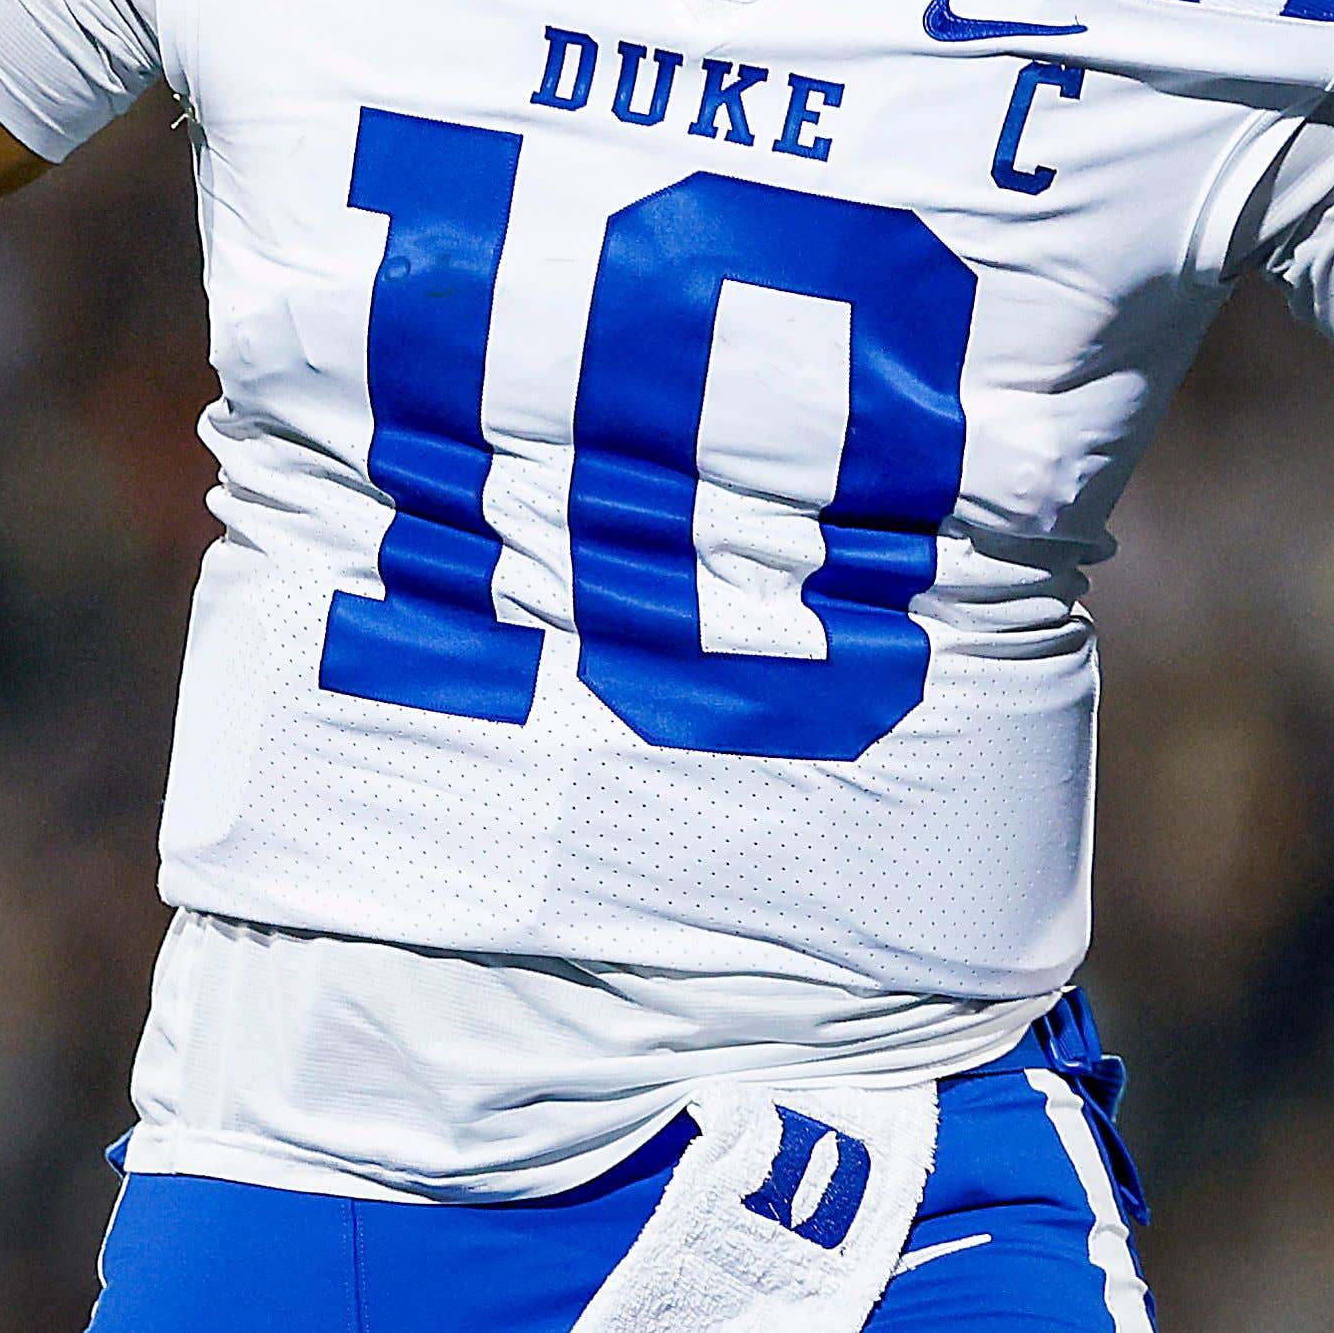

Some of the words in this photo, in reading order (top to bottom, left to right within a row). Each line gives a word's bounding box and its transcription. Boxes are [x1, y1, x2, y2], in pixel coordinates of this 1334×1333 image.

[530, 25, 845, 163] DUKE
[990, 60, 1085, 196] C
[318, 105, 979, 762] 10
[739, 1103, 872, 1250] D
